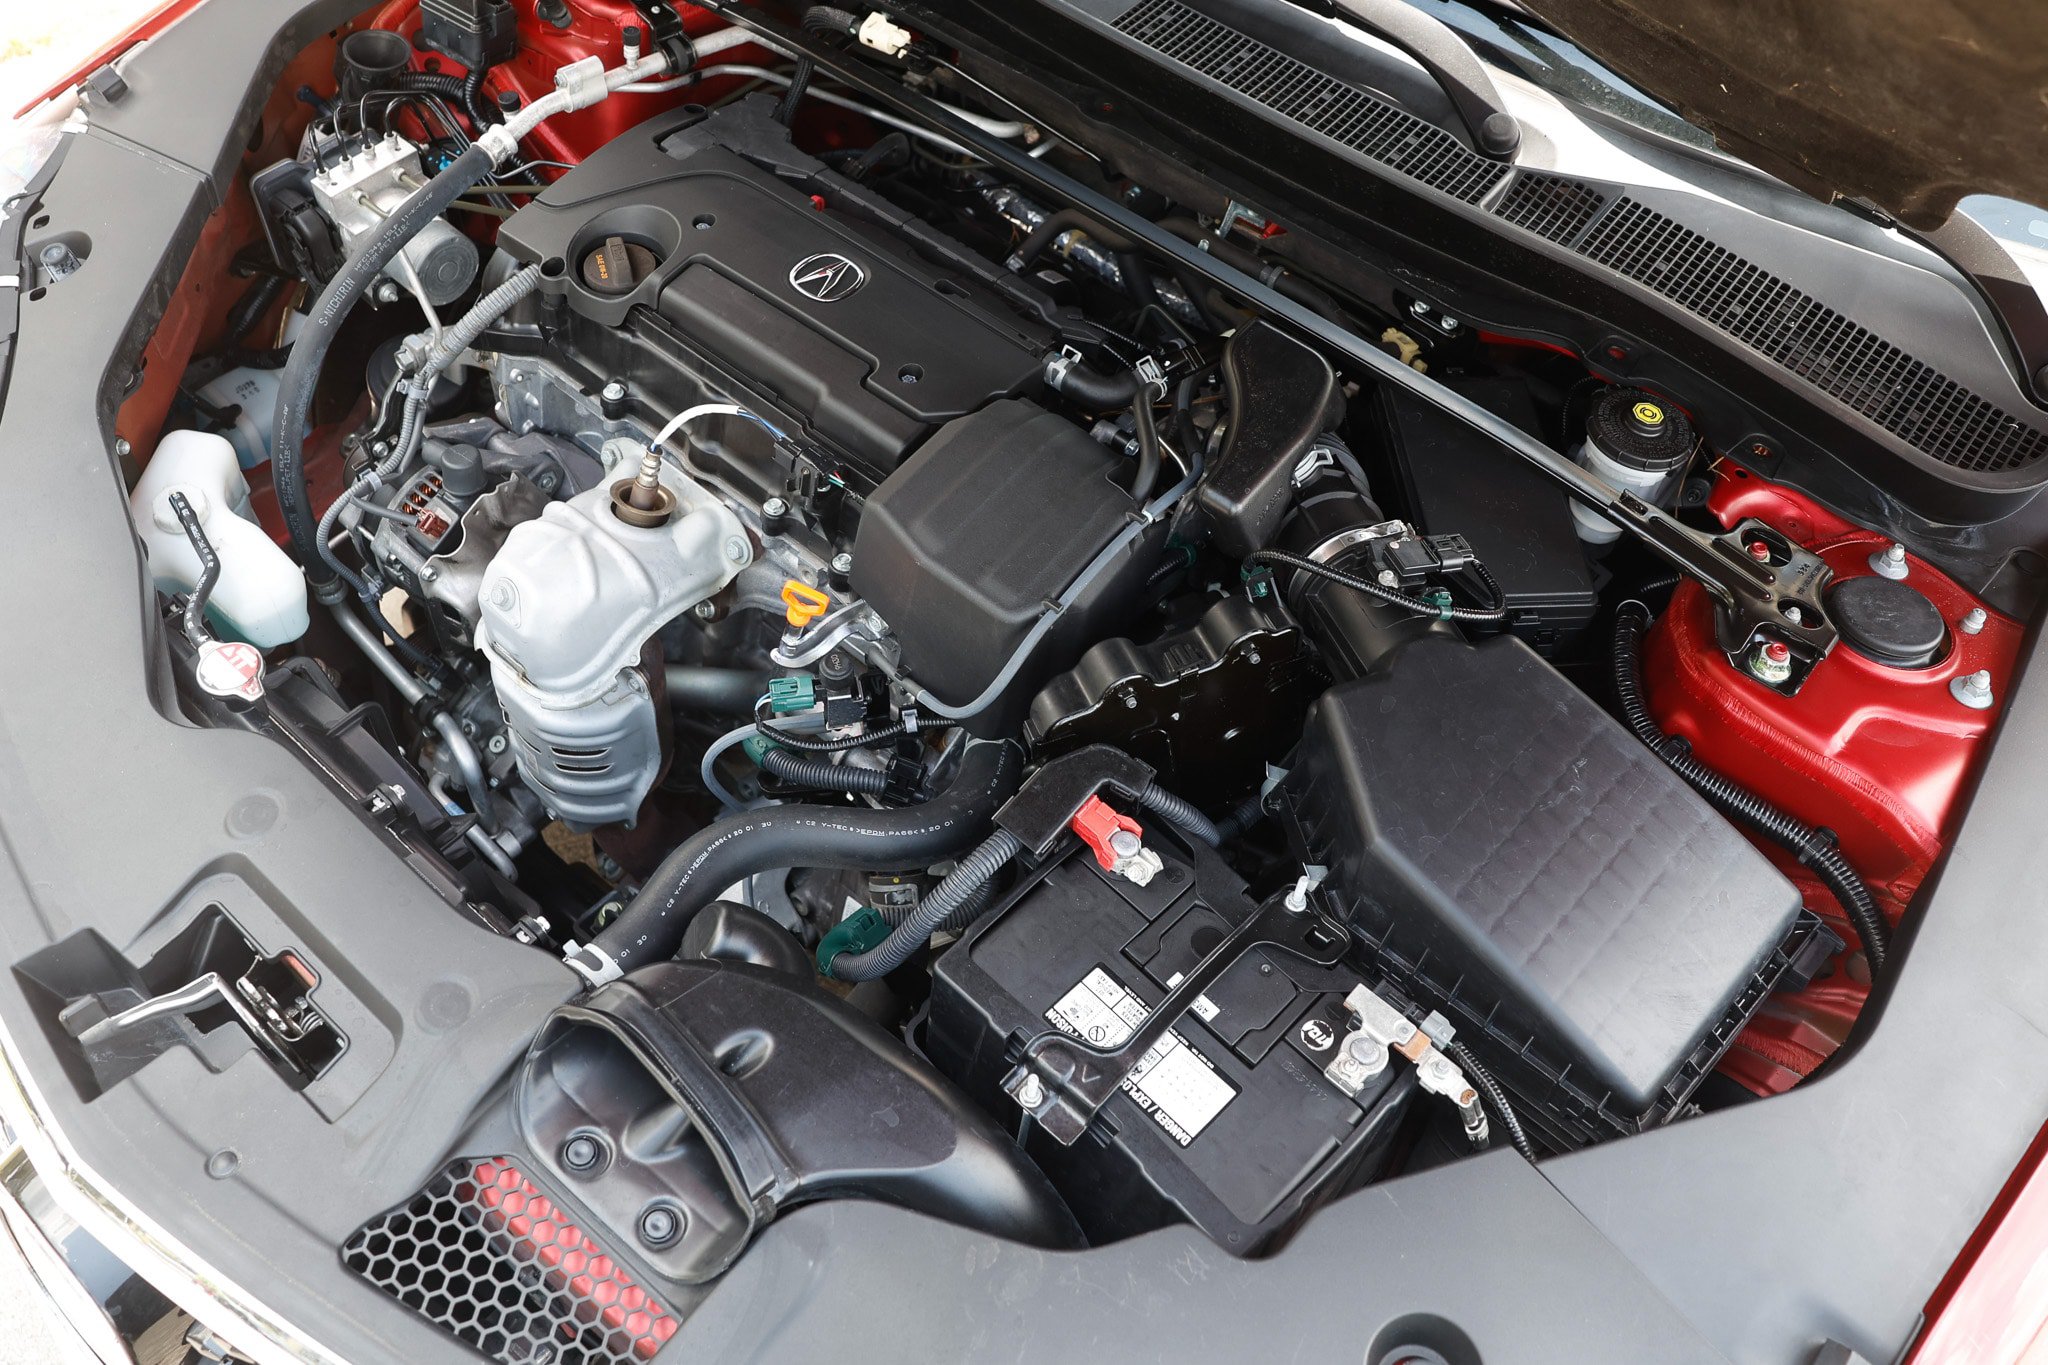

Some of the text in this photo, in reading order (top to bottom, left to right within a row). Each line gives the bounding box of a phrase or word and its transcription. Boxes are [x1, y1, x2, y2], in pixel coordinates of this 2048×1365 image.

[595, 254, 604, 264] SAE
[821, 822, 847, 830] Y-TEC
[1135, 996, 1145, 1006] AND
[1153, 1109, 1192, 1146] DANGER
